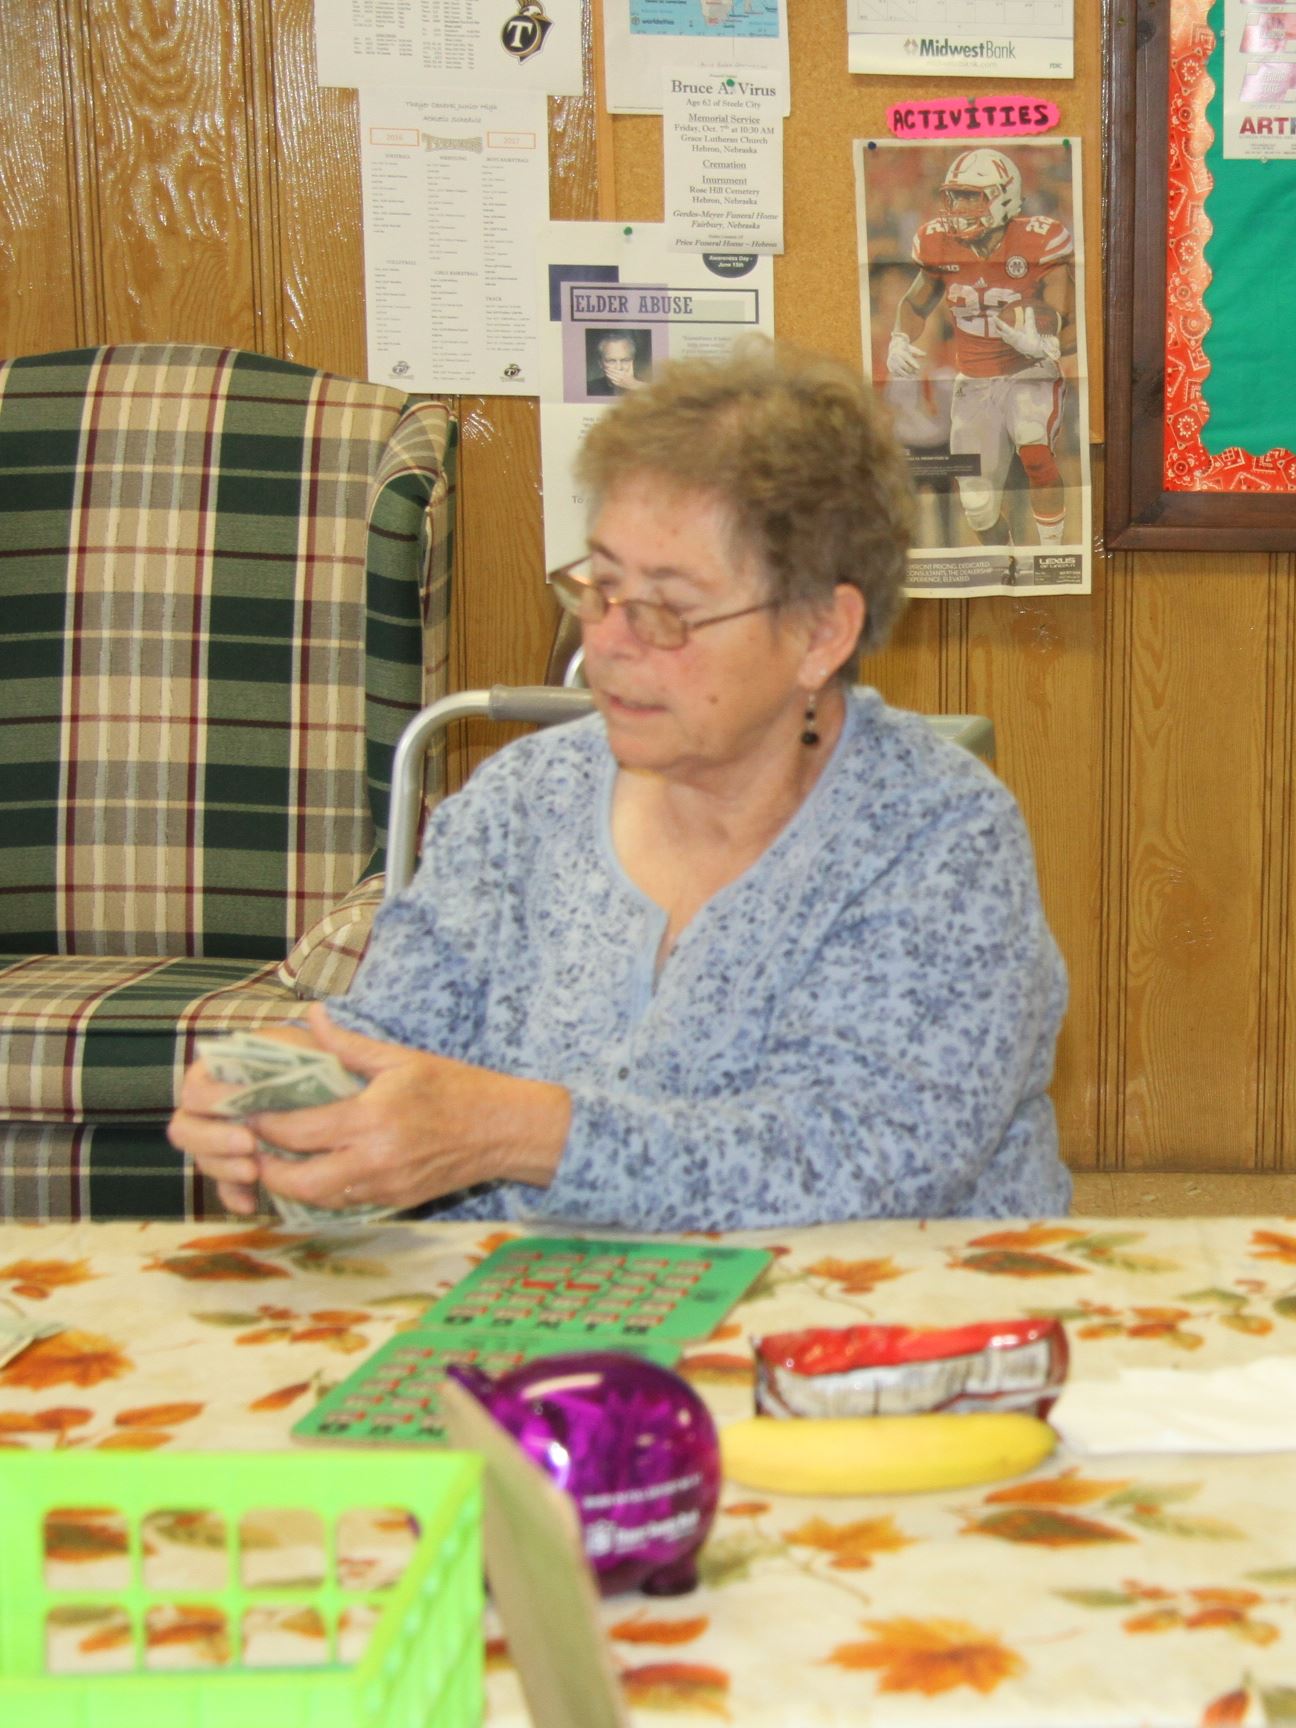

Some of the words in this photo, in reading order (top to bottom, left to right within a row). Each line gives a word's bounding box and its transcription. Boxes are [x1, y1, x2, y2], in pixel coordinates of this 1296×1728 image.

[507, 21, 533, 48] T
[671, 79, 714, 95] Bruce
[718, 82, 735, 95] A.
[738, 82, 777, 97] Virus
[686, 98, 701, 108] Age
[713, 99, 721, 107] of
[722, 100, 743, 108] Steele
[745, 101, 761, 111] City
[688, 113, 729, 124] Memorial
[730, 115, 761, 125] Service
[893, 103, 1050, 132] ACTIVITIES
[674, 124, 701, 134] Friday,
[702, 125, 718, 133] Oct.
[740, 127, 759, 135] 10:30
[680, 134, 703, 143] Grace
[704, 135, 739, 144] Lutheran
[740, 136, 768, 145] Church
[691, 145, 723, 154] Hebron,
[724, 146, 758, 154] Nebraska
[702, 160, 747, 170] Cremation
[702, 175, 748, 186] Inurnment
[689, 185, 708, 194] Rose
[709, 186, 724, 194] Hill
[724, 187, 760, 197] Cemetery
[691, 196, 722, 206] Hebron,
[724, 197, 758, 206] Nebraska
[726, 211, 755, 221] Funeral
[756, 212, 779, 221] Home
[691, 220, 725, 230] Fairbury,
[727, 221, 761, 230] Nebraska
[694, 239, 722, 248] Funeral
[722, 240, 744, 248] Home
[751, 241, 778, 249] Hebron
[575, 295, 629, 314] ELDER
[638, 296, 694, 315] ABUSE
